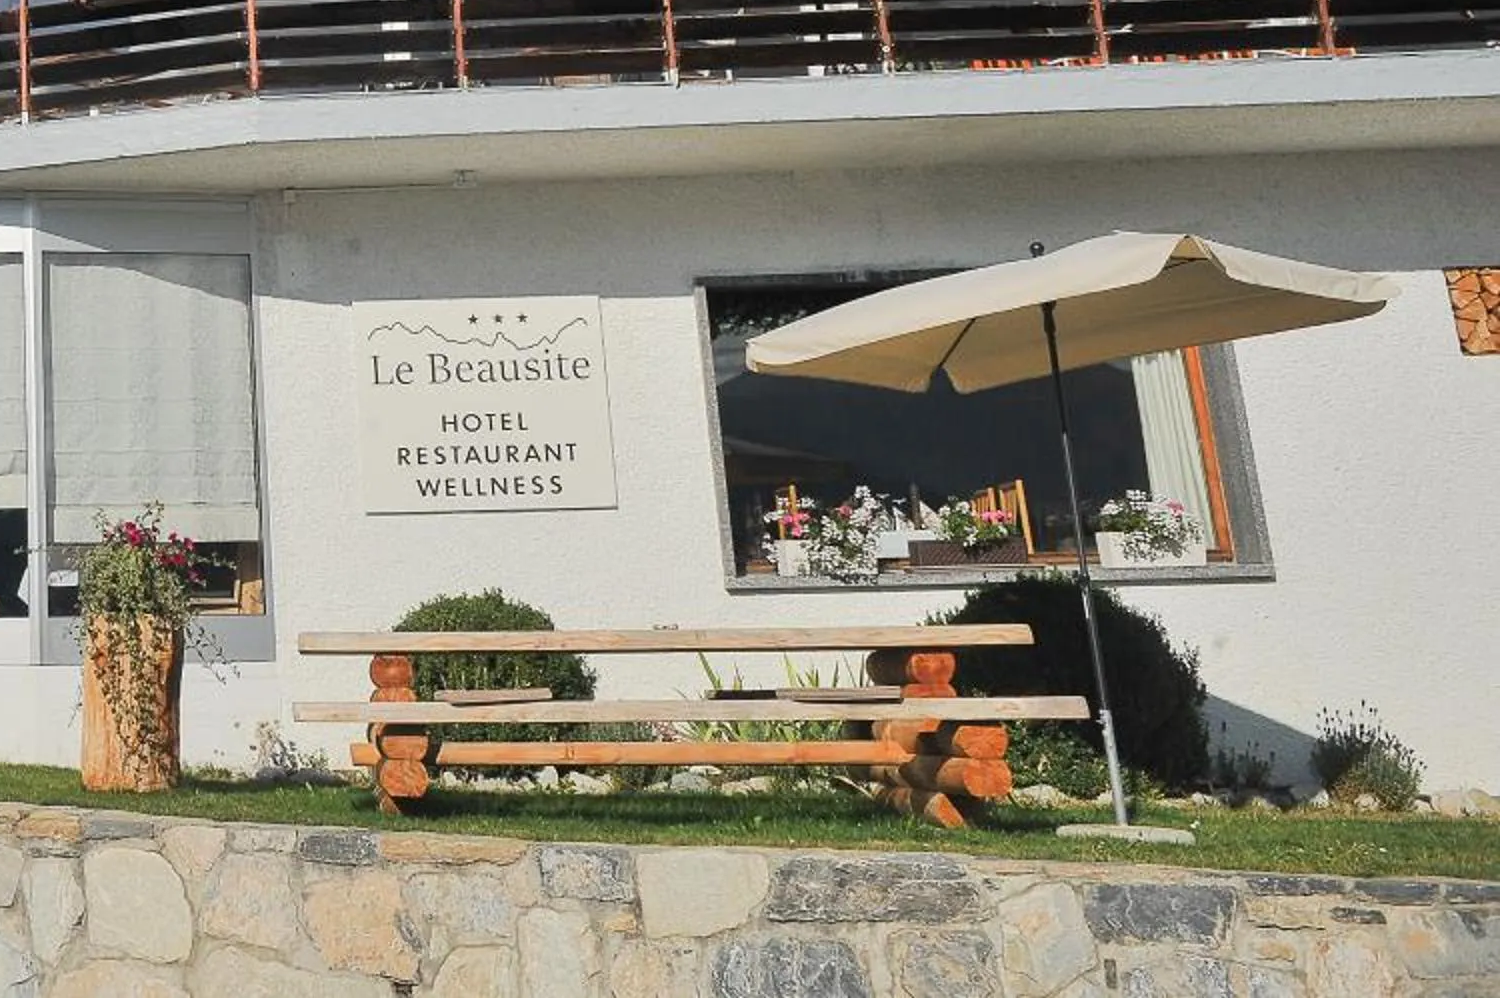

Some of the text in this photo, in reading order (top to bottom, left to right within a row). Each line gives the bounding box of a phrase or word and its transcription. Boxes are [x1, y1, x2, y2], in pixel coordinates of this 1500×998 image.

[371, 348, 591, 386] Le Beausite
[441, 412, 529, 433] HOTEL
[396, 442, 578, 466] RESTAURANT
[416, 474, 564, 497] WELLNESS
